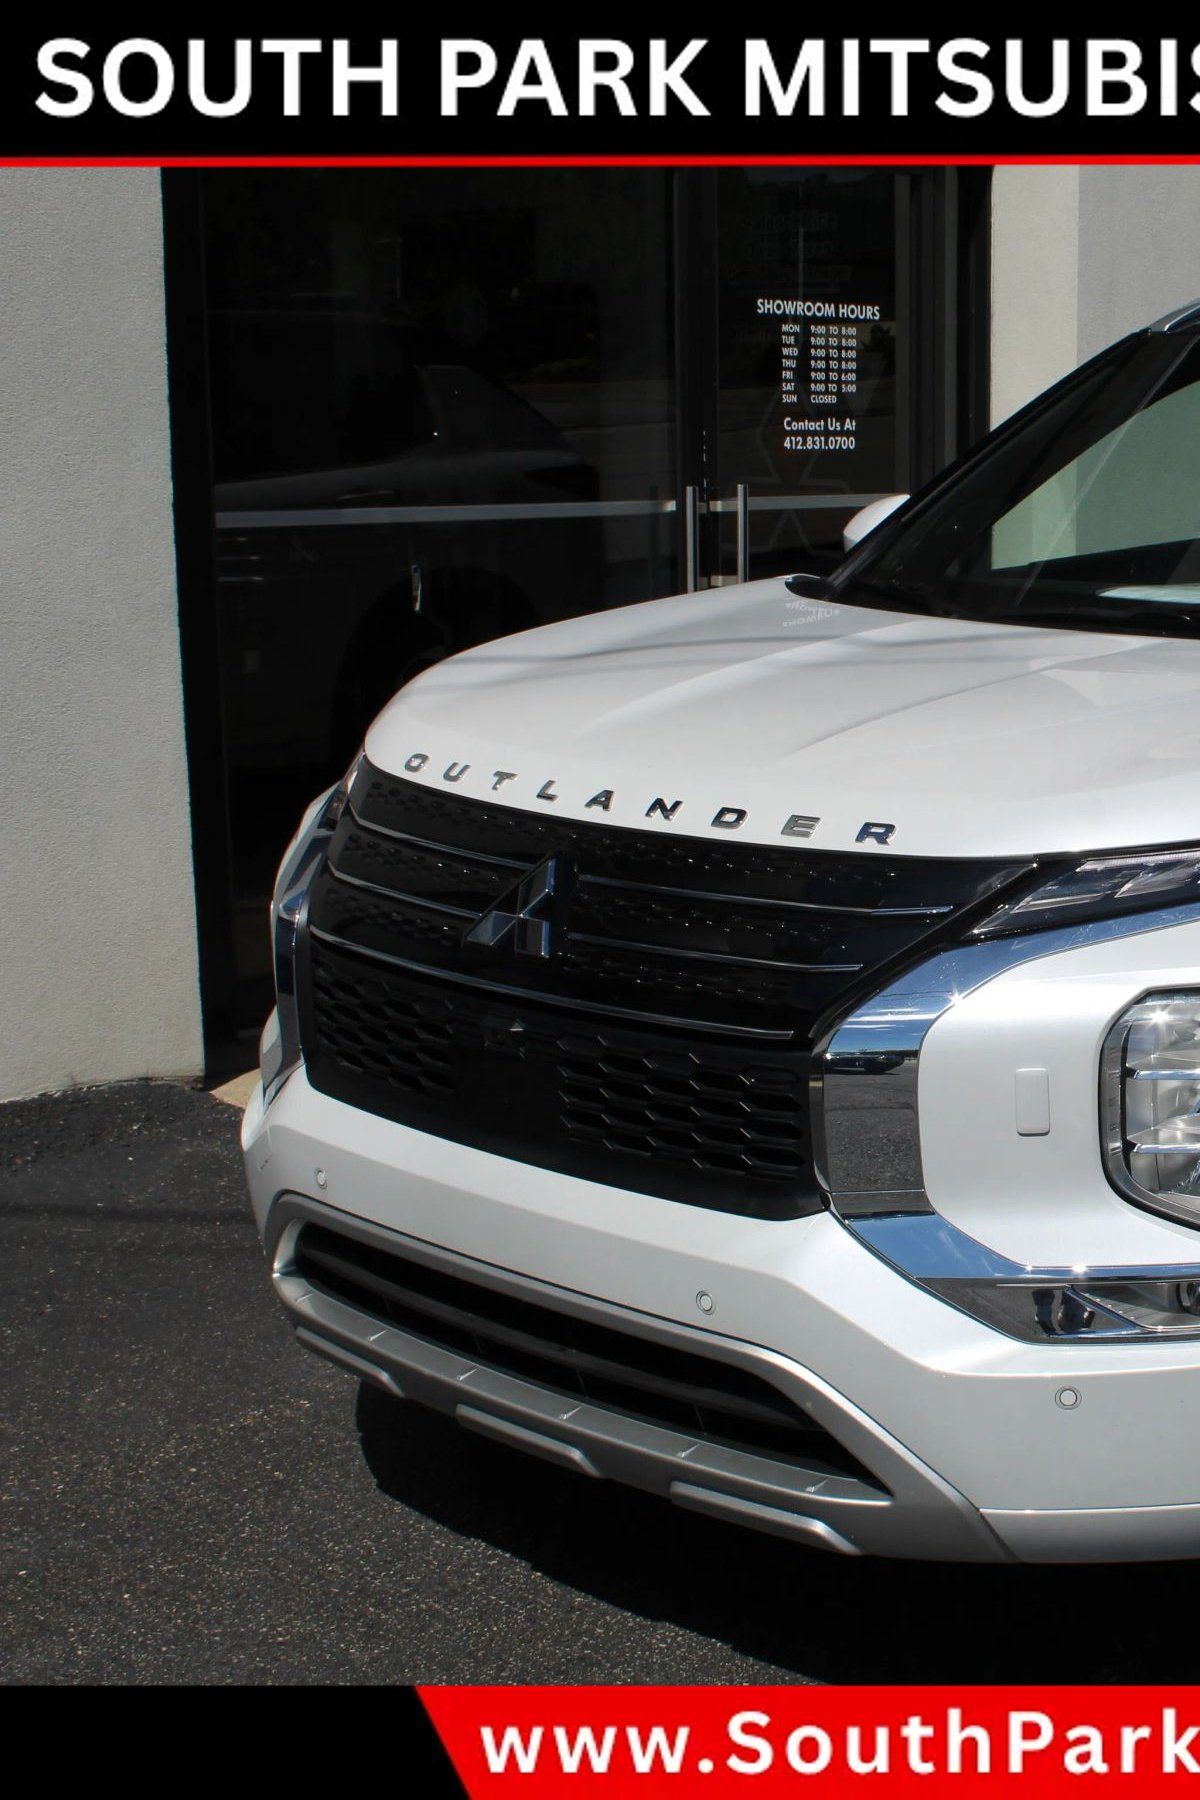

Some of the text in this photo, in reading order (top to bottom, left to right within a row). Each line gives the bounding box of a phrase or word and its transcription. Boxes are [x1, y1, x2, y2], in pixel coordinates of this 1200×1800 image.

[757, 299, 880, 320] SHOWROOM HOURS
[782, 324, 857, 336] MON 9:00 TO 8:00
[782, 336, 857, 347] TUE 9:00 TO 8:00
[782, 347, 856, 358] WED 9:00 TO 8:00
[782, 359, 856, 370] THU 9:00 TO 8:00
[782, 371, 856, 381] FRI 9:00 TO 6:00
[782, 382, 856, 393] SAT 9:00 TO 5:00
[782, 394, 837, 404] SUN CLOSED
[784, 417, 856, 431] Contact Us At
[784, 437, 855, 450] 412.831.0700
[404, 752, 897, 847] OUTLANDER
